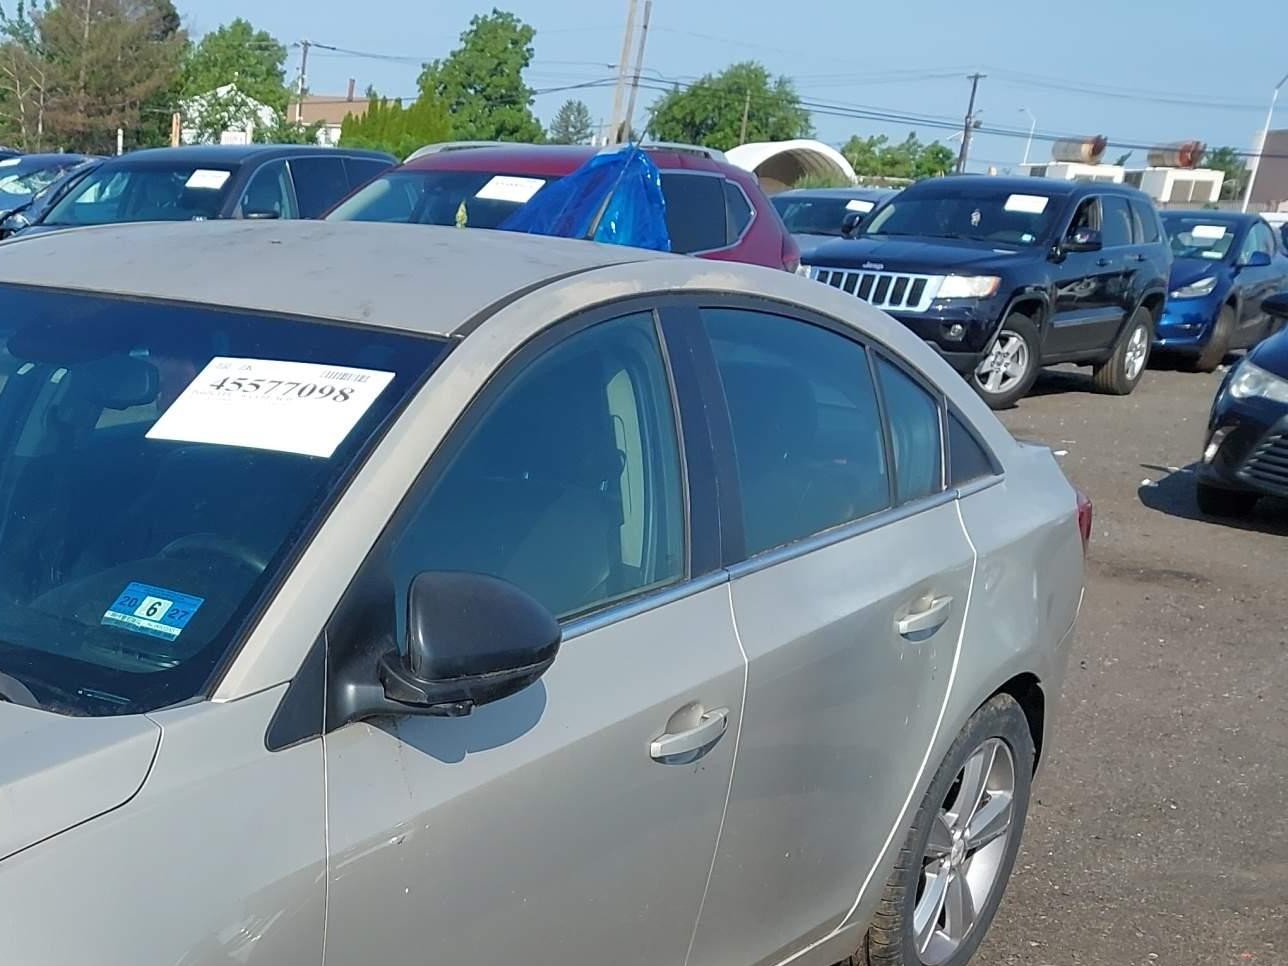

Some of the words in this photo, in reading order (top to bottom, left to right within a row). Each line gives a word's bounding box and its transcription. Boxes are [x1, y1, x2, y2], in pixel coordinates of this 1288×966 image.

[209, 376, 355, 402] 45577098
[120, 596, 139, 608] 20
[146, 601, 162, 617] 6
[168, 608, 191, 620] 27
